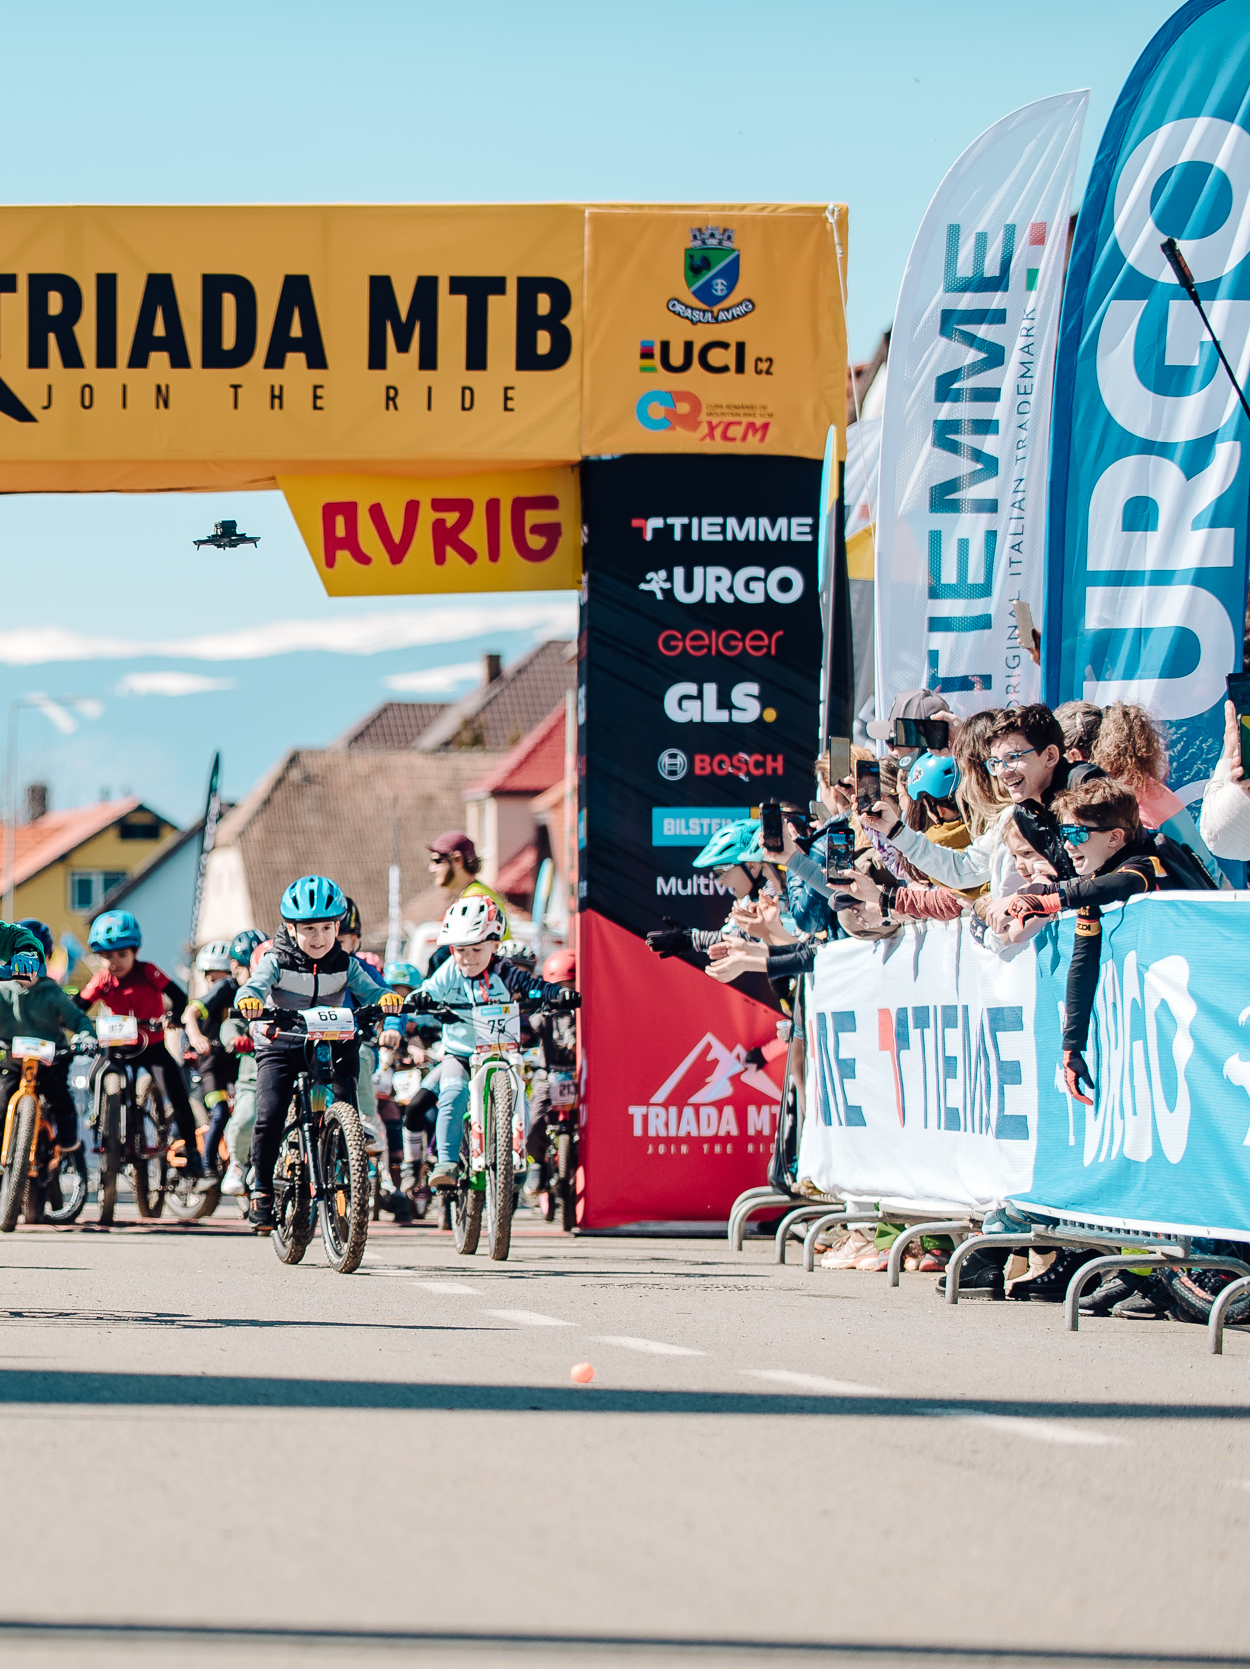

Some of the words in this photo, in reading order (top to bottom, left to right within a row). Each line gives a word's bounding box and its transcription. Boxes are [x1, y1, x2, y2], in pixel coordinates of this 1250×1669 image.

[367, 274, 574, 372] MTB
[717, 299, 754, 322] AVRIG
[659, 340, 746, 374] UCI
[754, 357, 774, 376] C2
[41, 383, 170, 411] JOIN
[230, 384, 325, 411] THE
[385, 386, 517, 412] RIDE
[1013, 307, 1037, 465] TRADEMARK
[699, 420, 771, 443] XCM
[1083, 116, 1250, 722] URGO
[321, 495, 562, 570] AVRIG
[666, 517, 813, 542] TIEMME
[1008, 478, 1027, 576] ITALIAN
[673, 567, 804, 603] URGO
[694, 753, 784, 777] BOSCH
[318, 1010, 337, 1021] 66
[487, 1018, 505, 1034] 75
[628, 1104, 740, 1137] TRIADA
[647, 1143, 689, 1155] JOIN
[702, 1142, 735, 1155] THE
